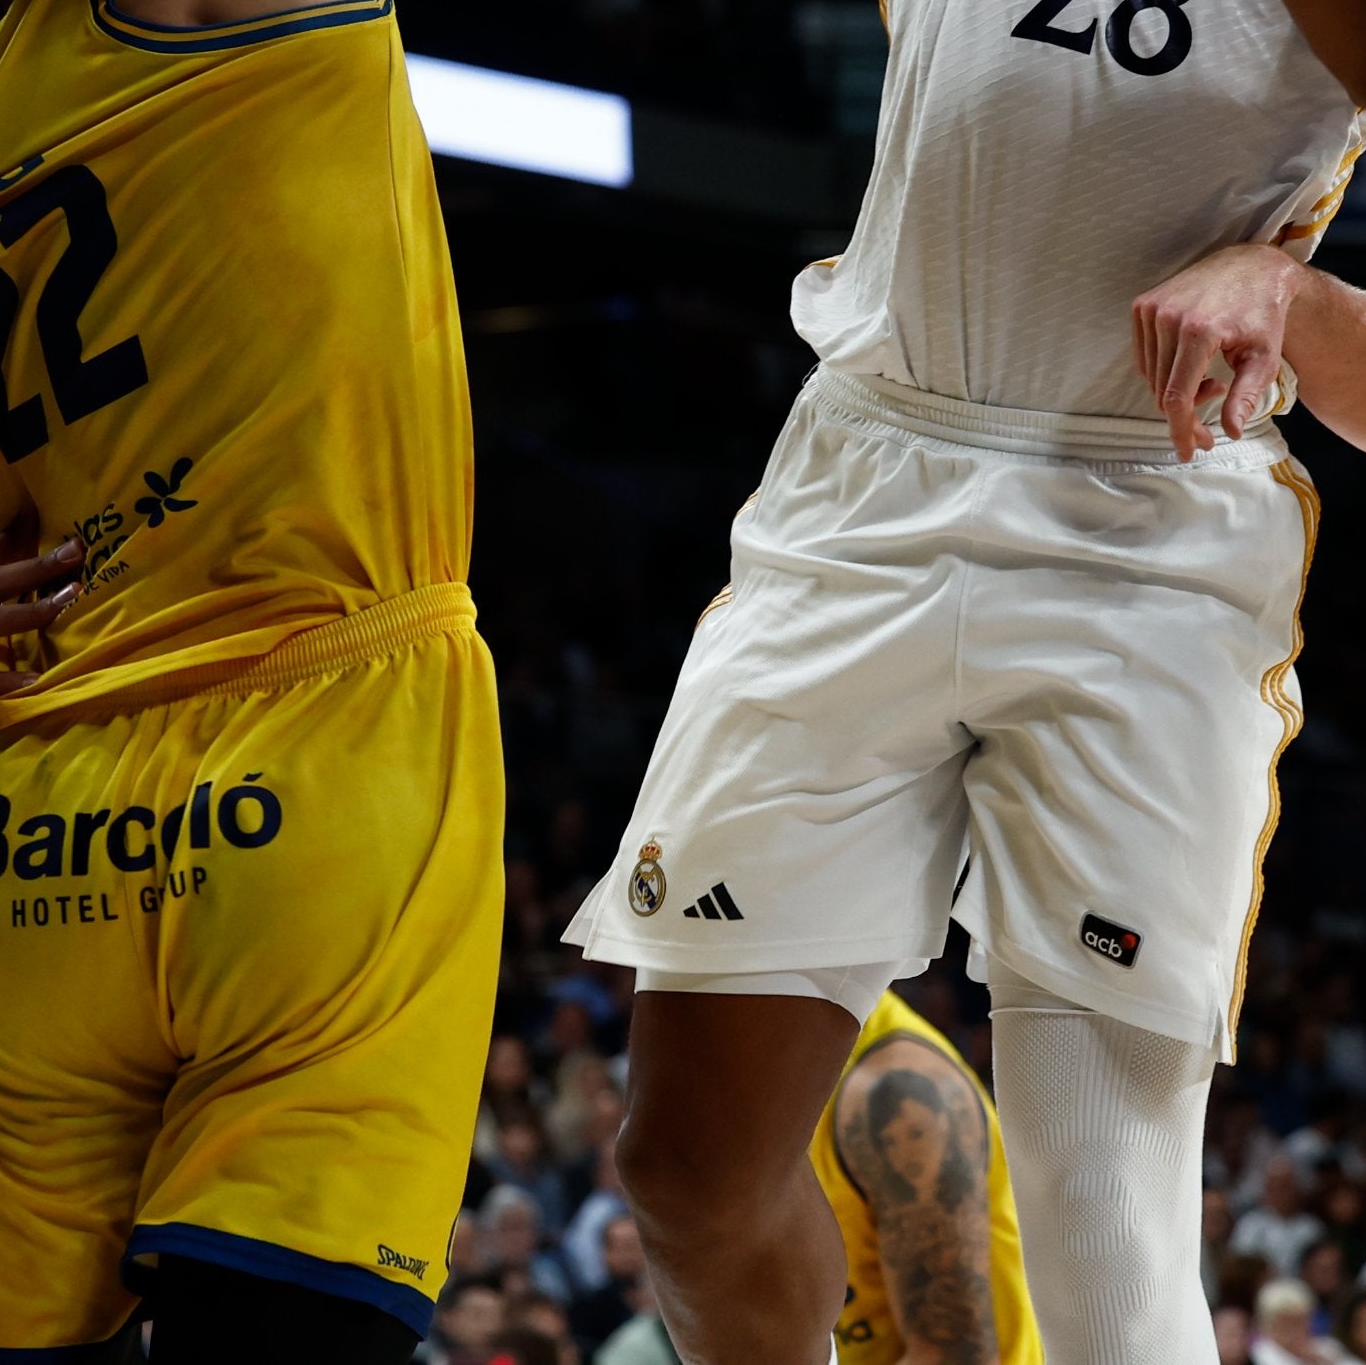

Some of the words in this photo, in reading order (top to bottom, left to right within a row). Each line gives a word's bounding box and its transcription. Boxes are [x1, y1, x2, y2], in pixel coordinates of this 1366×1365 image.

[97, 560, 131, 584] VIDA
[11, 892, 119, 929] HOTEL
[1085, 931, 1123, 958] acb
[377, 1243, 430, 1281] SPALDING
